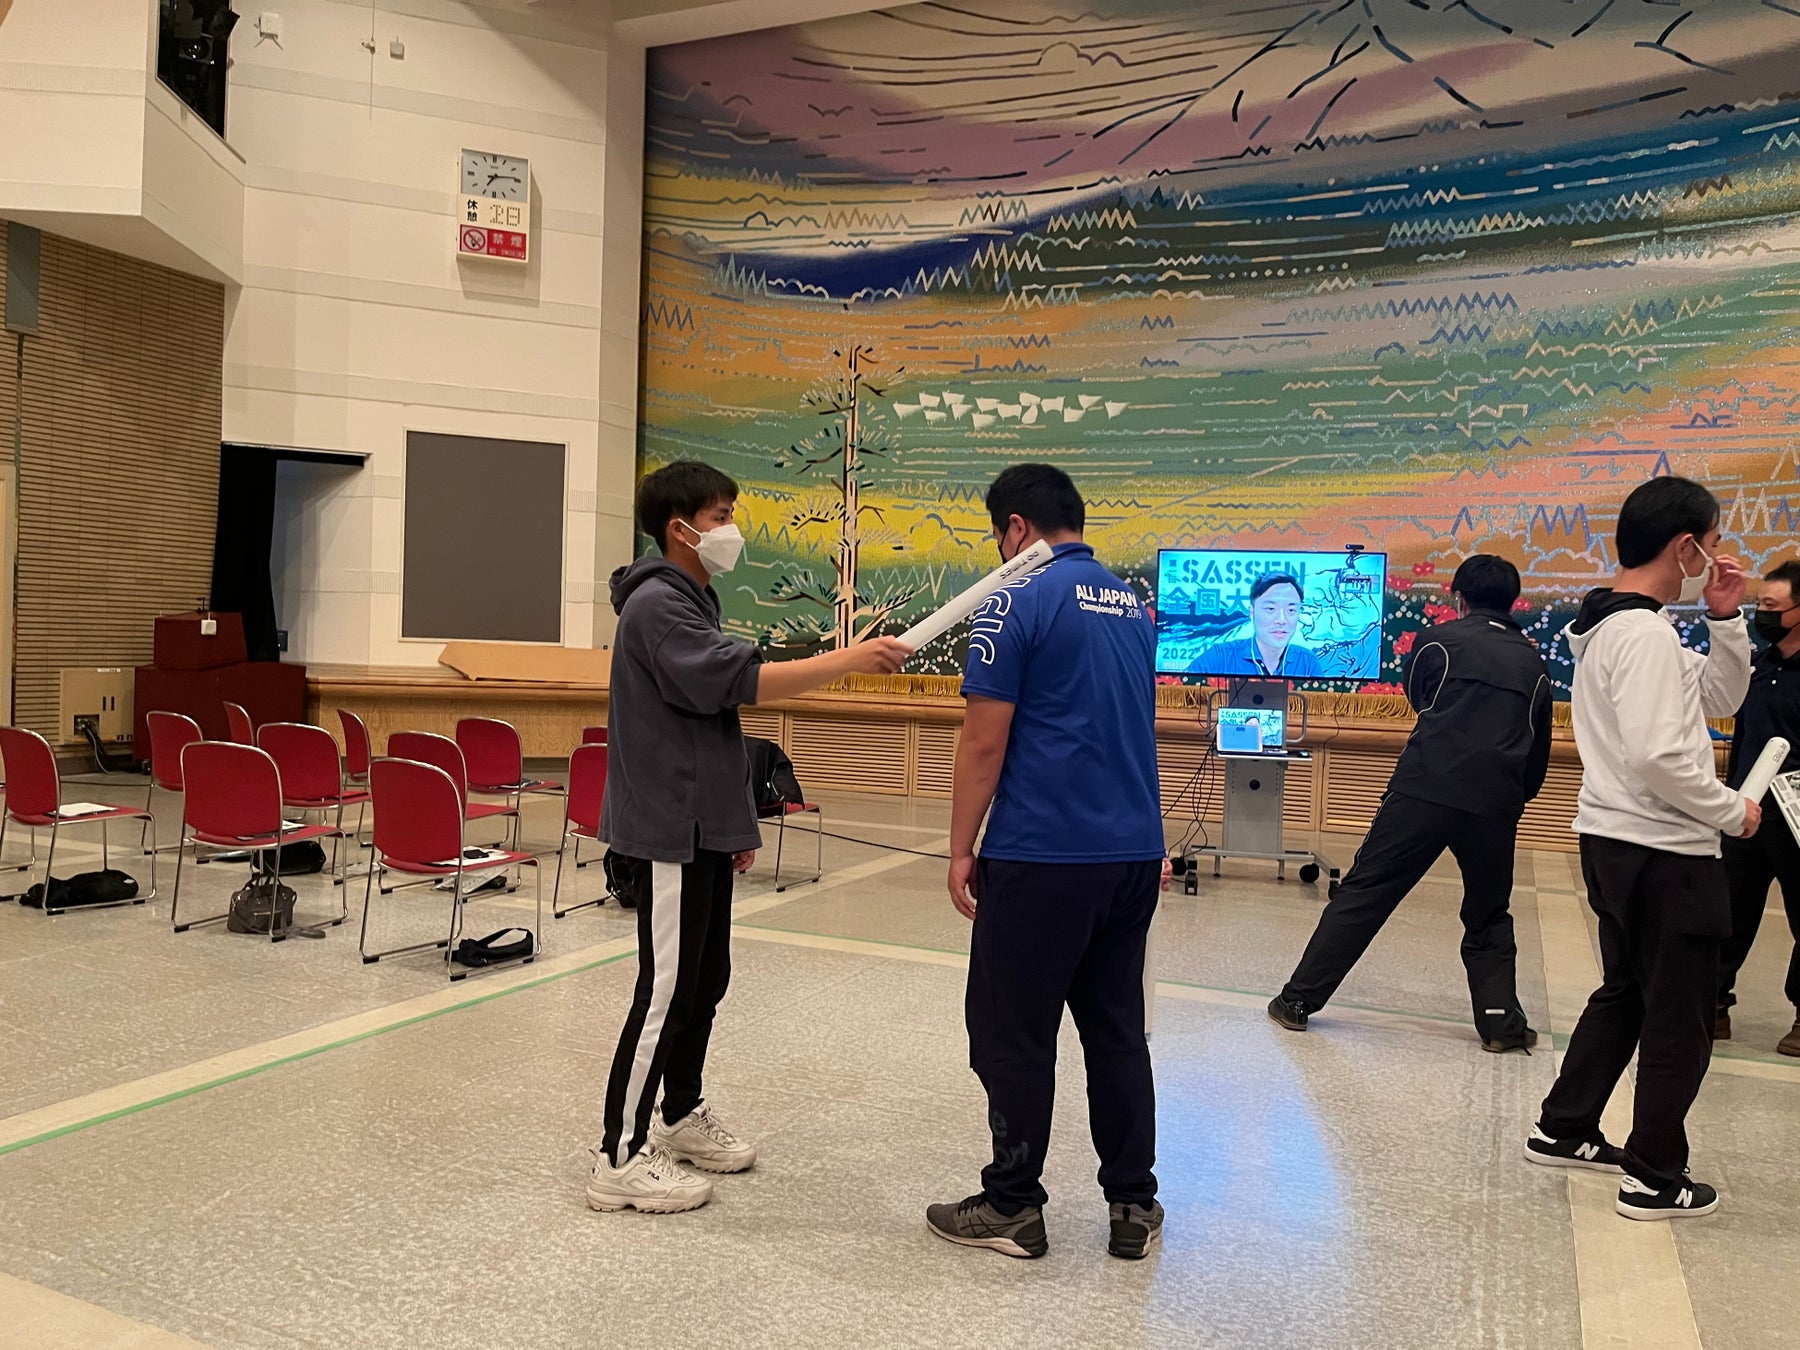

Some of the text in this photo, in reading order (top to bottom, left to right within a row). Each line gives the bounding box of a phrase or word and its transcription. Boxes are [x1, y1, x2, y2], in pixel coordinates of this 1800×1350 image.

[1075, 584, 1138, 608] ALL JAPAN
[1079, 601, 1142, 619] Championship 2019
[1162, 647, 1195, 660] 2022
[1574, 1142, 1600, 1160] N
[1674, 1187, 1693, 1208] N
